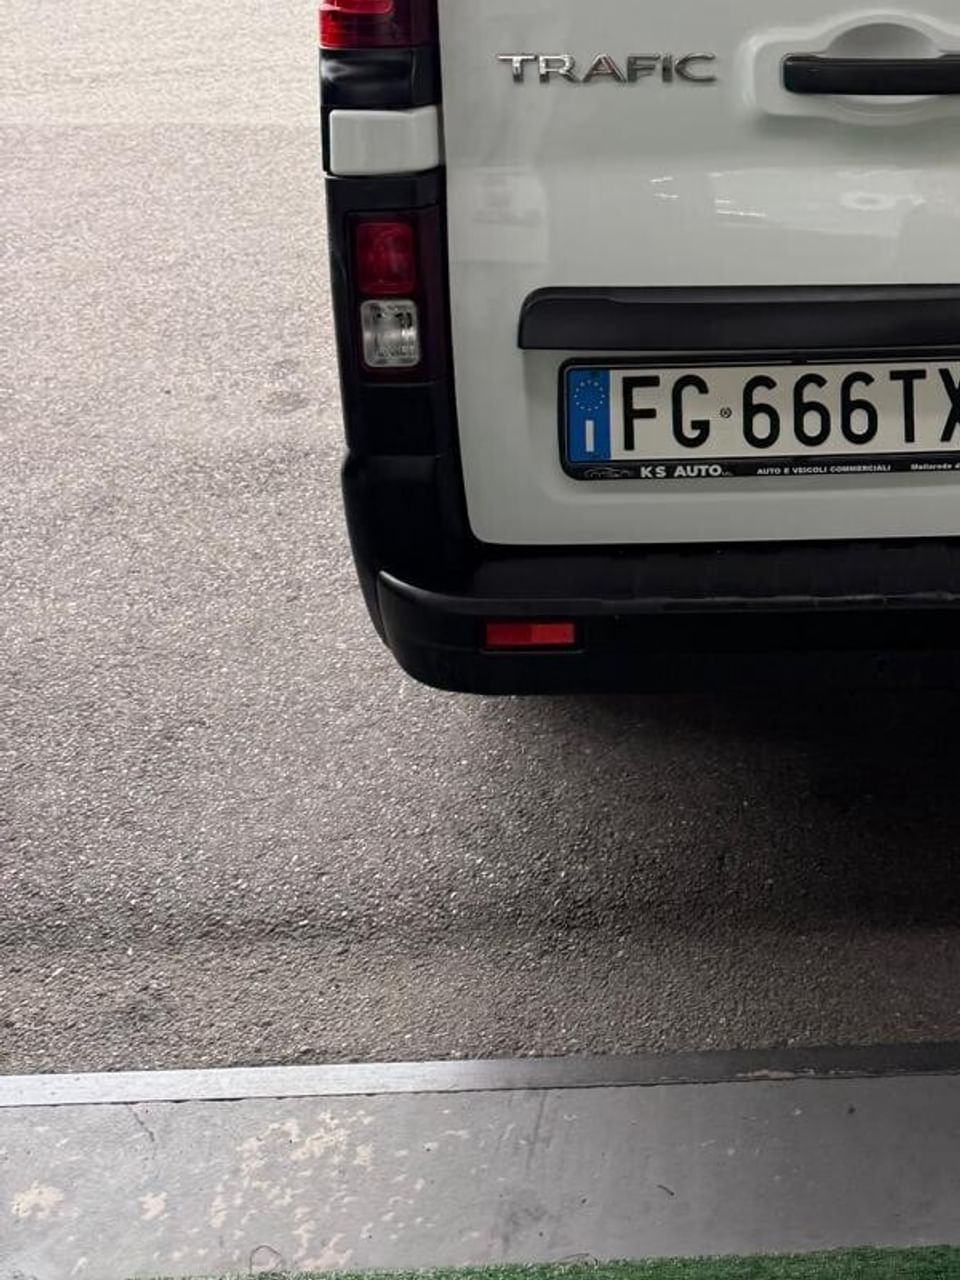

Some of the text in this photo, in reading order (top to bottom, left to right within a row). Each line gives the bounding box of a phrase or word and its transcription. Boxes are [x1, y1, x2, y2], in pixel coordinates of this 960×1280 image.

[497, 53, 718, 84] TRAFIC
[621, 375, 711, 452] FG
[674, 464, 722, 477] AUTO
[756, 467, 781, 475] AUTO
